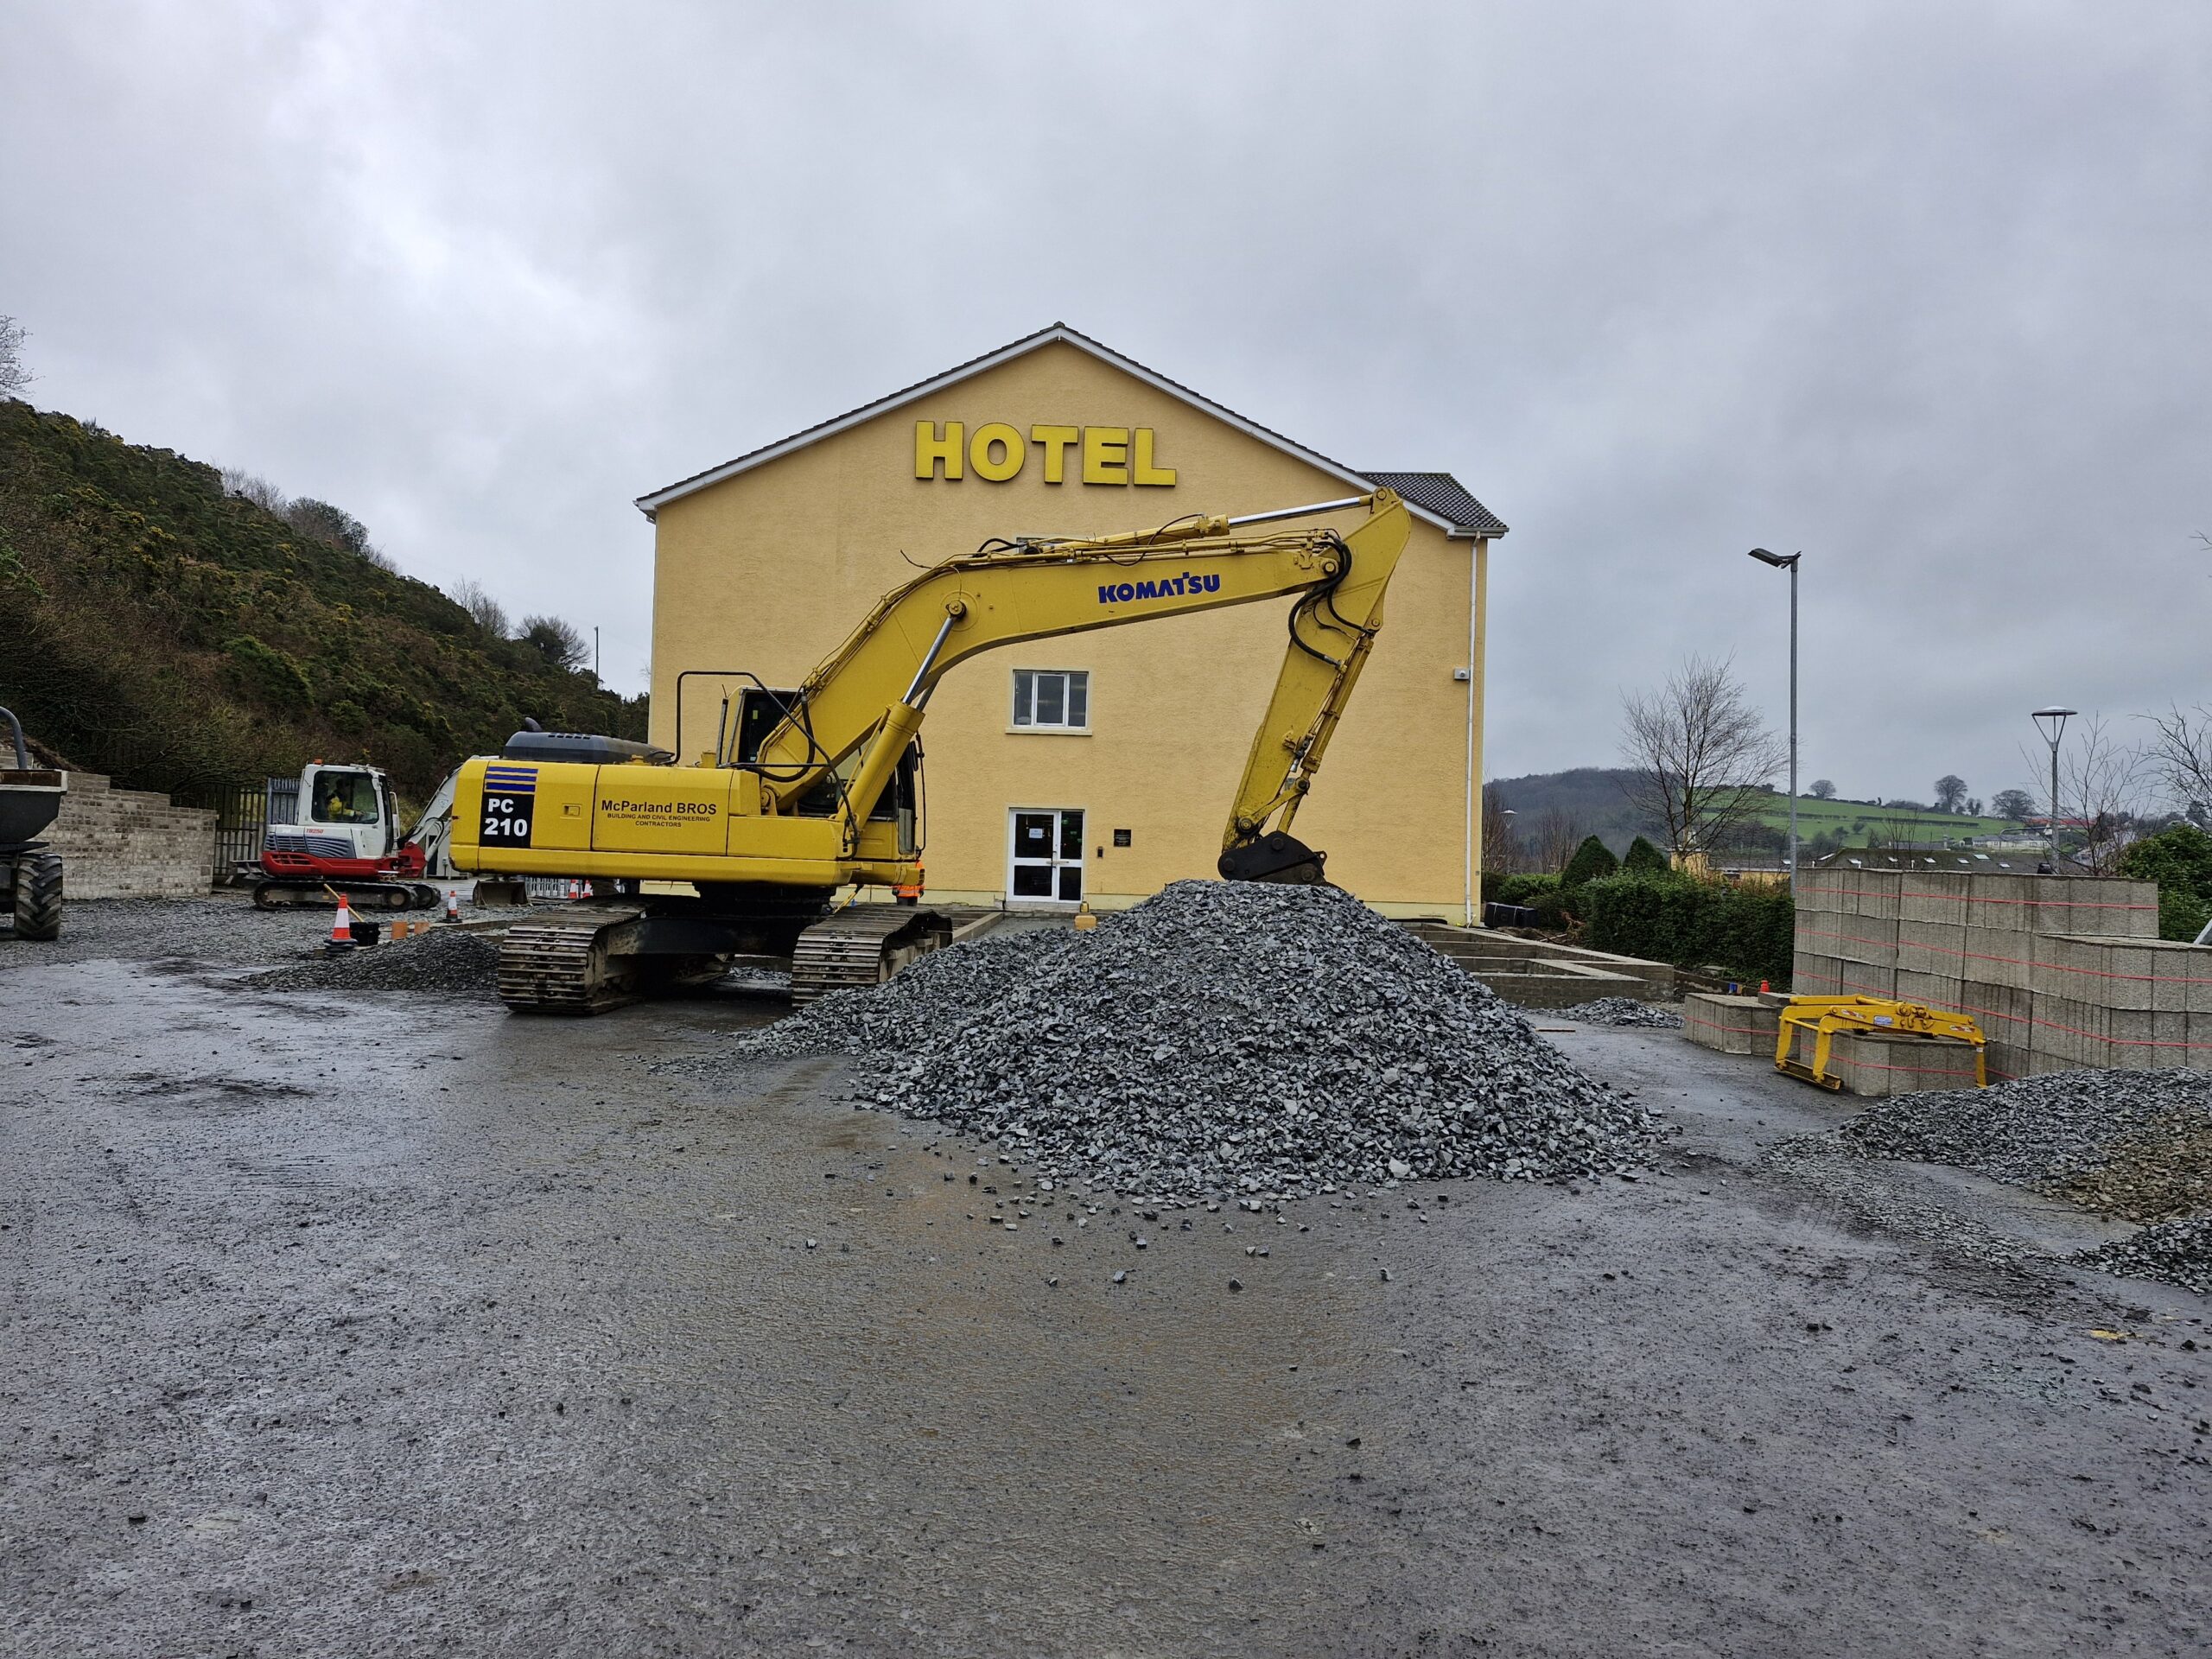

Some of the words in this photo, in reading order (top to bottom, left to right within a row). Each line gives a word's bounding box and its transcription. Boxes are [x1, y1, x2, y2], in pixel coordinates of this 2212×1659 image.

[915, 421, 1177, 486] HOTEL
[1098, 572, 1221, 603] KOMATSU
[488, 798, 514, 813] PC
[601, 799, 672, 813] McParland
[677, 802, 717, 815] BROS
[484, 817, 528, 837] 210
